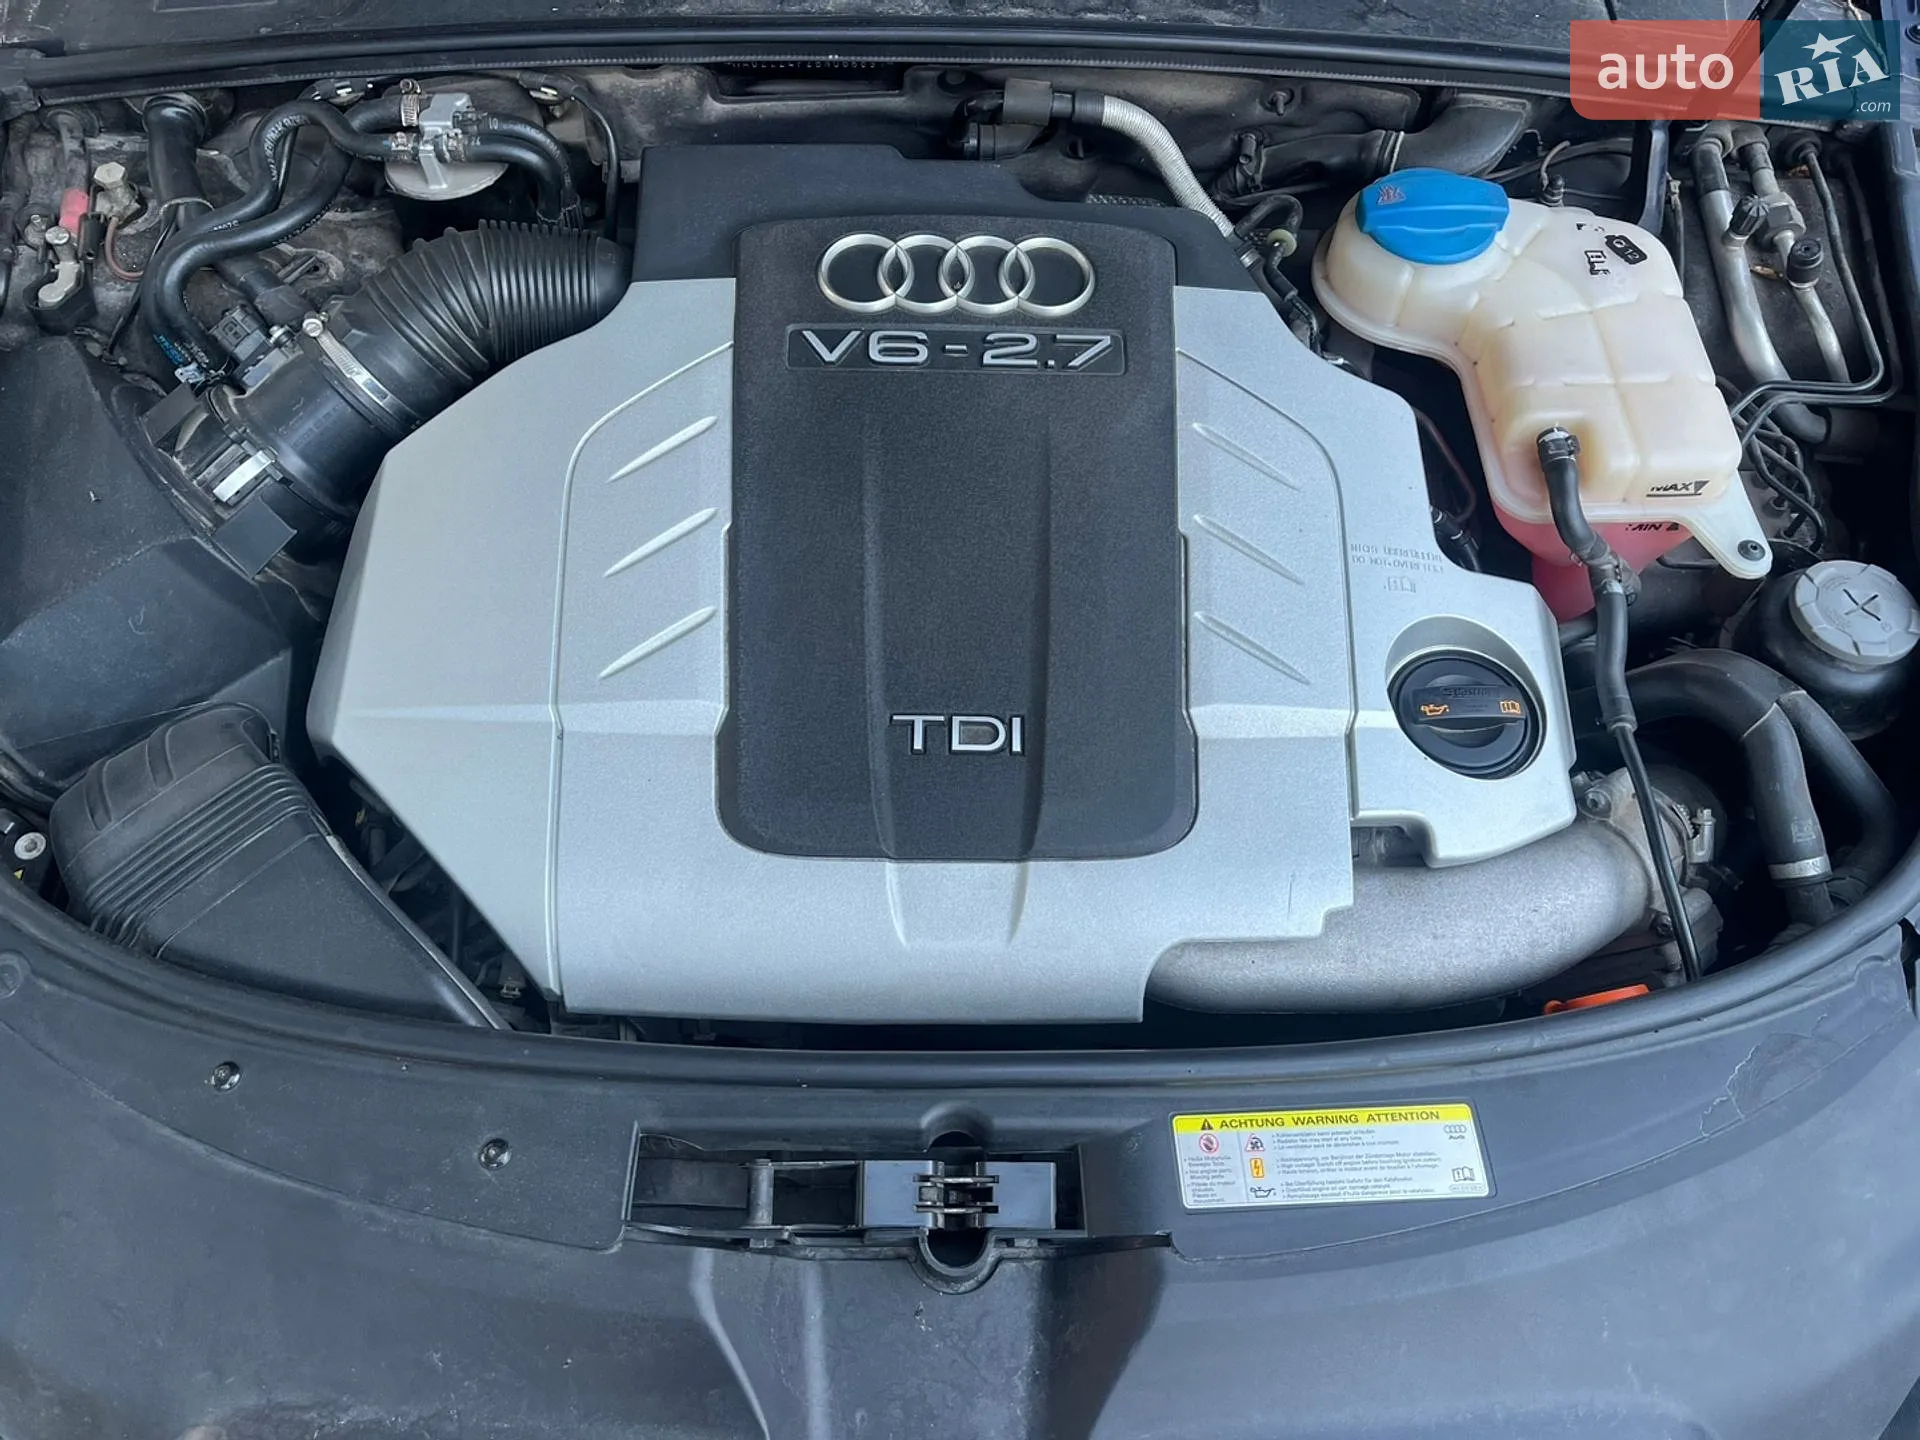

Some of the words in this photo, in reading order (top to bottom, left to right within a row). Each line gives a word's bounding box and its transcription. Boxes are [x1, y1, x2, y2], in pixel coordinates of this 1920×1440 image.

[892, 714, 1021, 753] TDI
[1219, 1117, 1285, 1129] ACHTUNG
[1291, 1114, 1359, 1126] WARNING
[1366, 1111, 1440, 1123] ATTENTION
